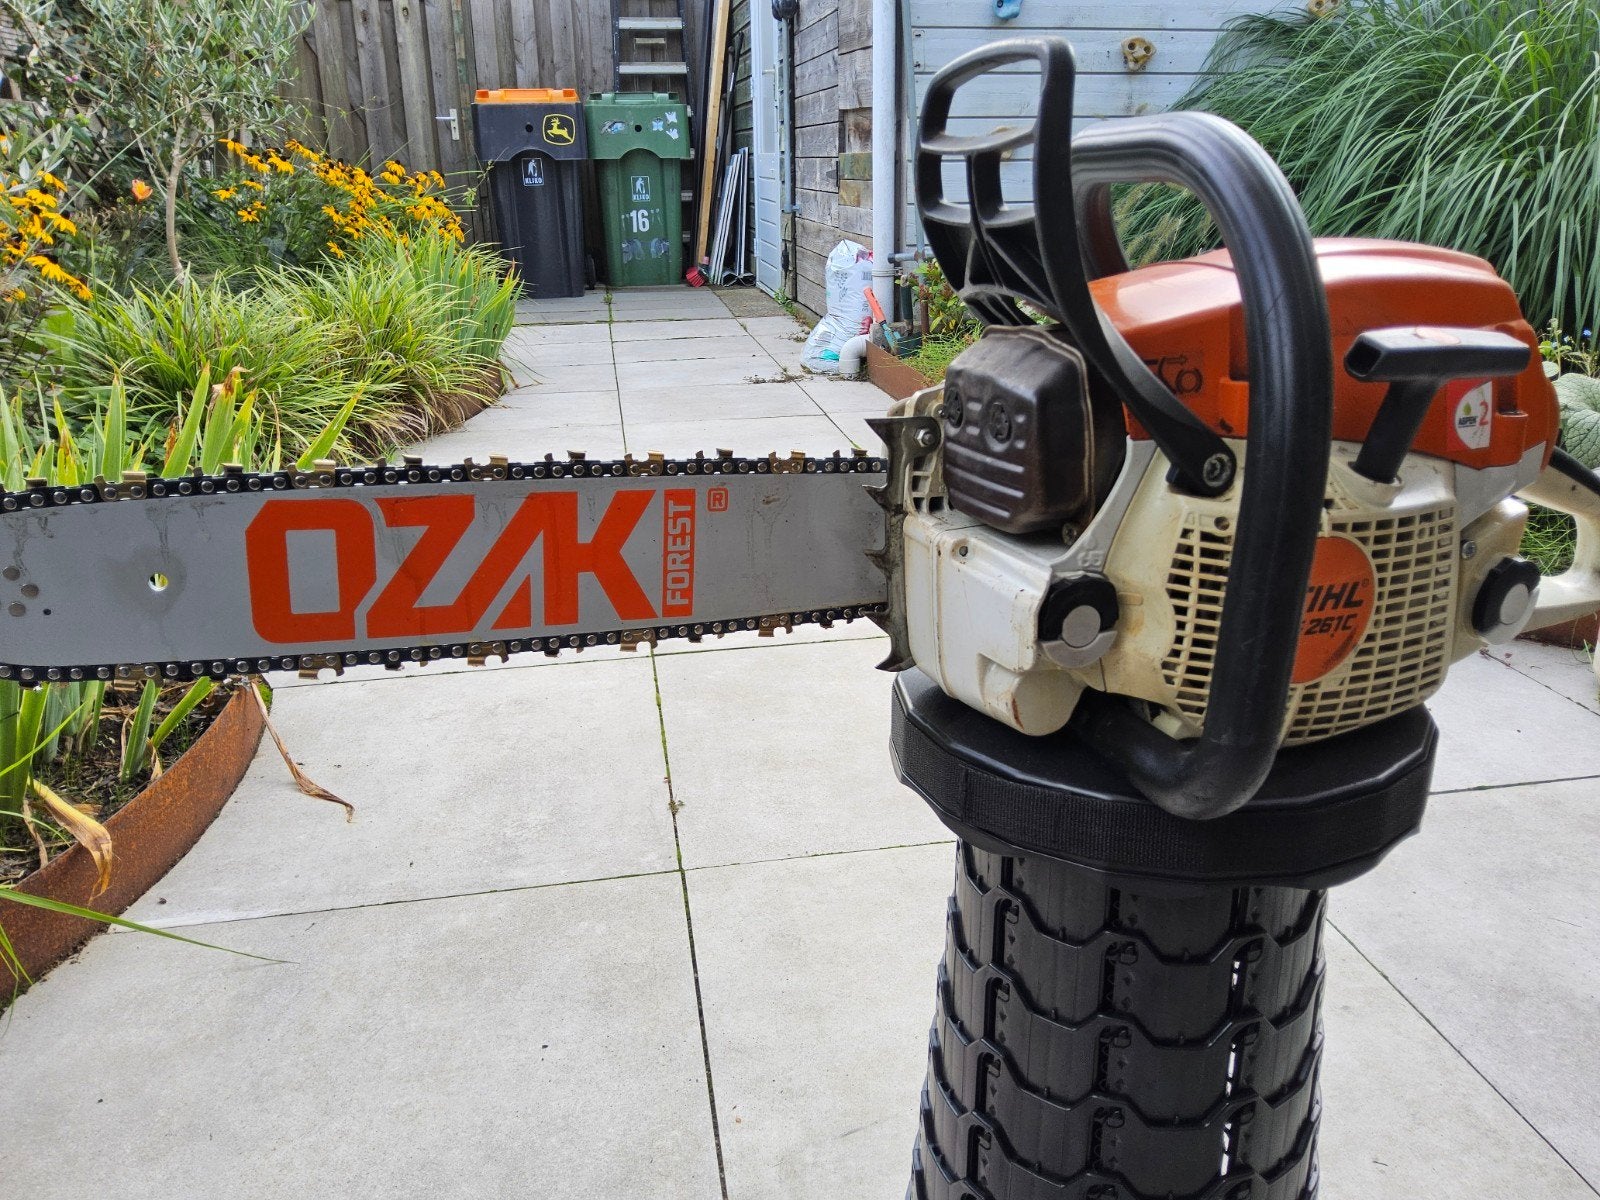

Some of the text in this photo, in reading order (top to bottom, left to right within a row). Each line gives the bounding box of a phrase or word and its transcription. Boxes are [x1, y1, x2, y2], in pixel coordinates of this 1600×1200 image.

[630, 209, 650, 233] 16
[1479, 400, 1489, 427] 2
[245, 489, 659, 644] OZAK
[666, 500, 692, 606] FOREST
[1307, 581, 1364, 613] IHL
